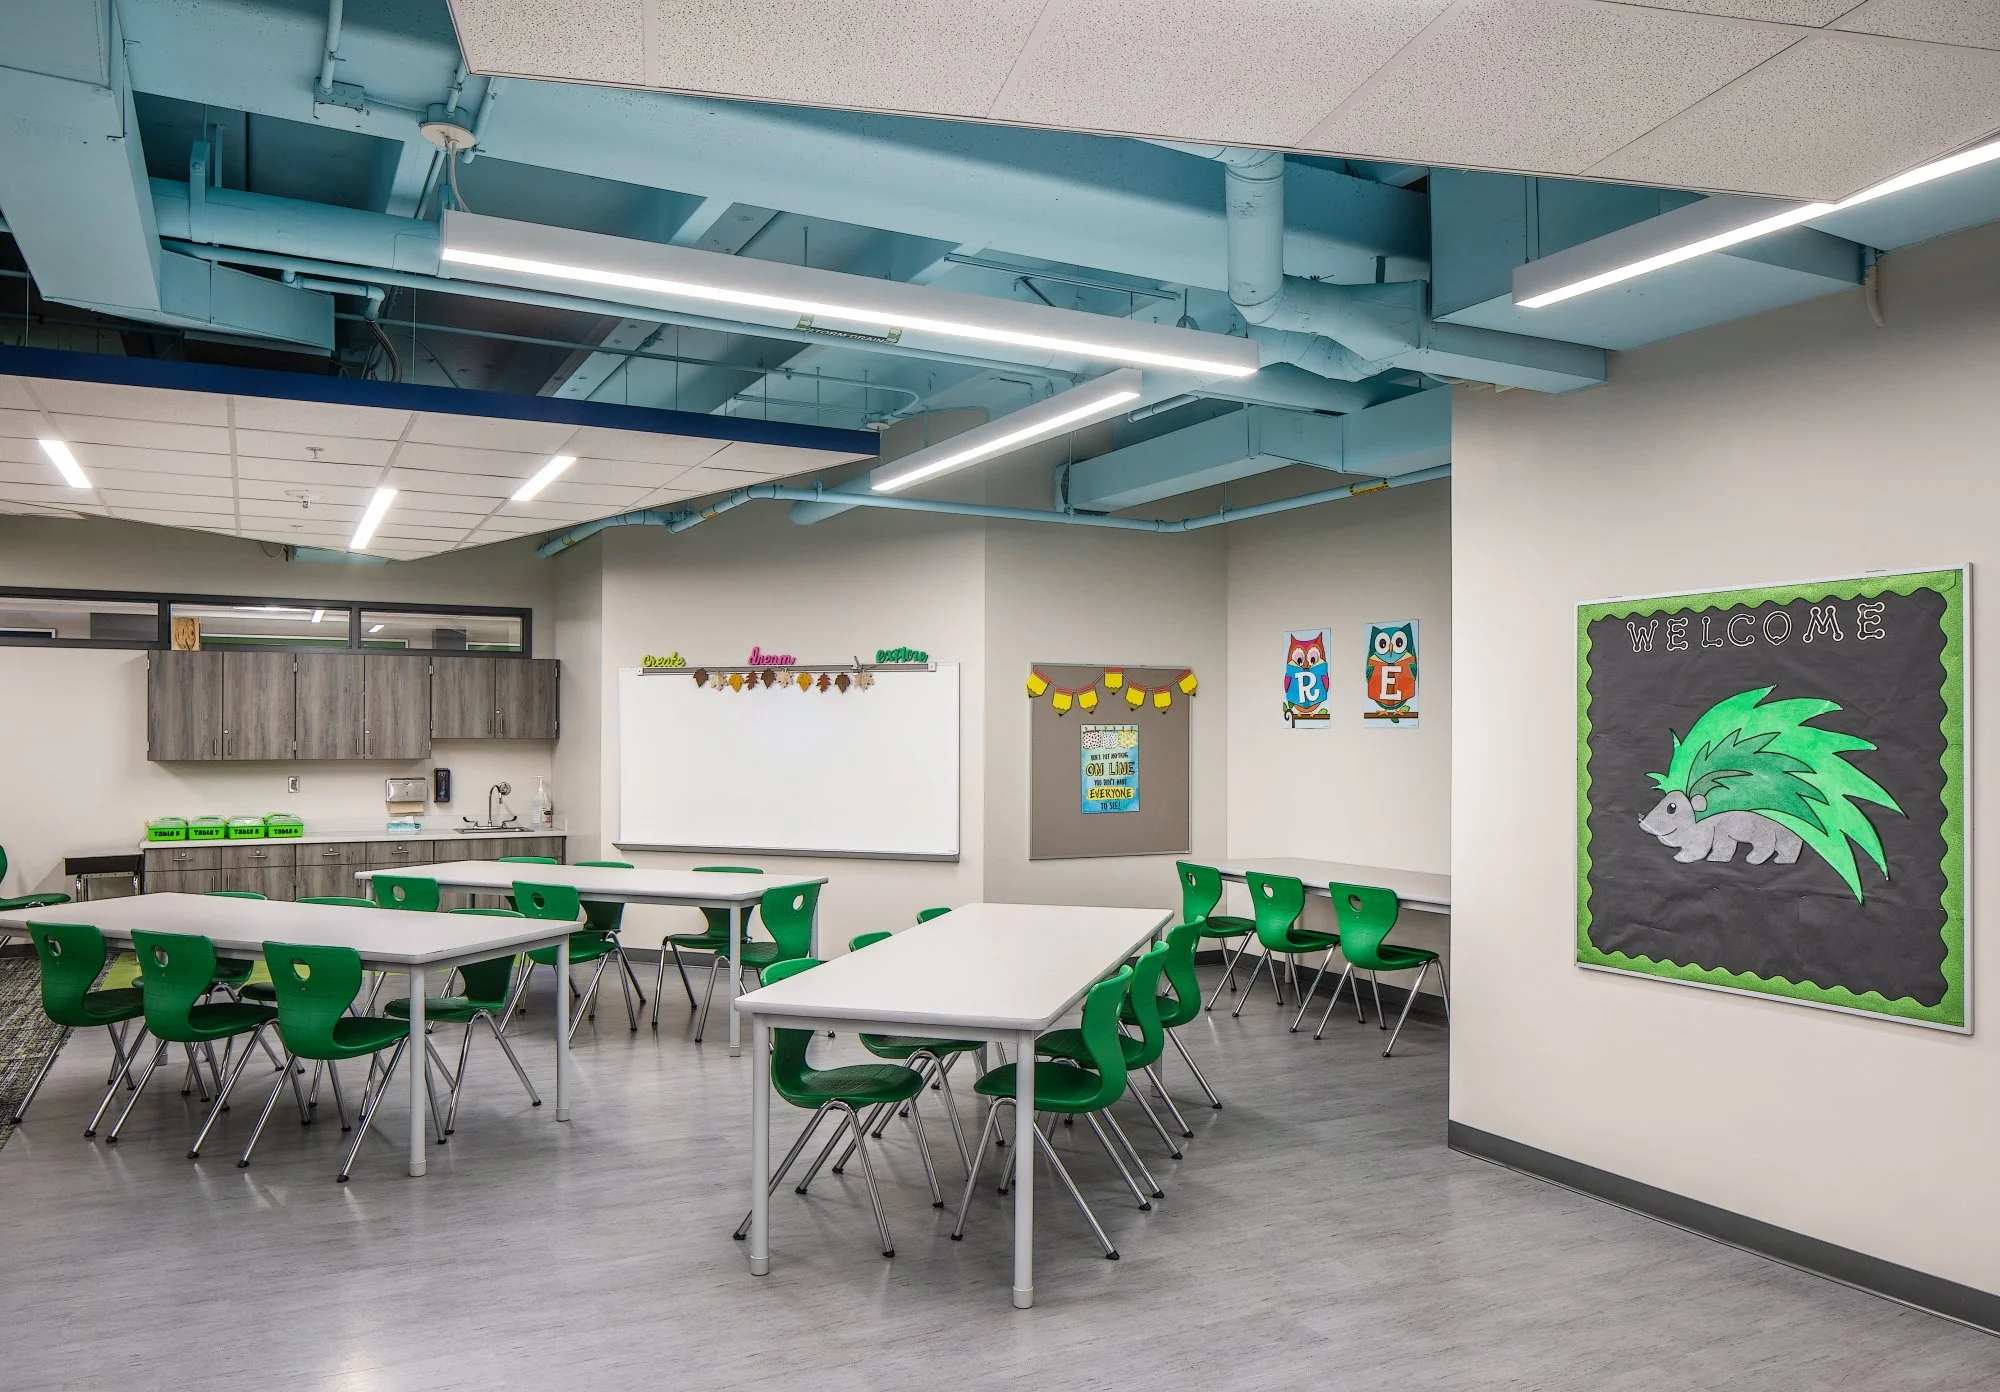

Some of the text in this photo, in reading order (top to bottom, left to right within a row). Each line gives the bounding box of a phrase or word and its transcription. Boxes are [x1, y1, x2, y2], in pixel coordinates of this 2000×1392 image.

[1626, 601, 1886, 653] WELCOME
[747, 646, 797, 666] dream
[875, 646, 929, 664] explore
[1295, 671, 1320, 703] R
[1379, 665, 1403, 701] E
[1086, 763, 1104, 776] ON
[1089, 787, 1132, 799] EVERYONE
[1100, 801, 1121, 811] TO SEE!
